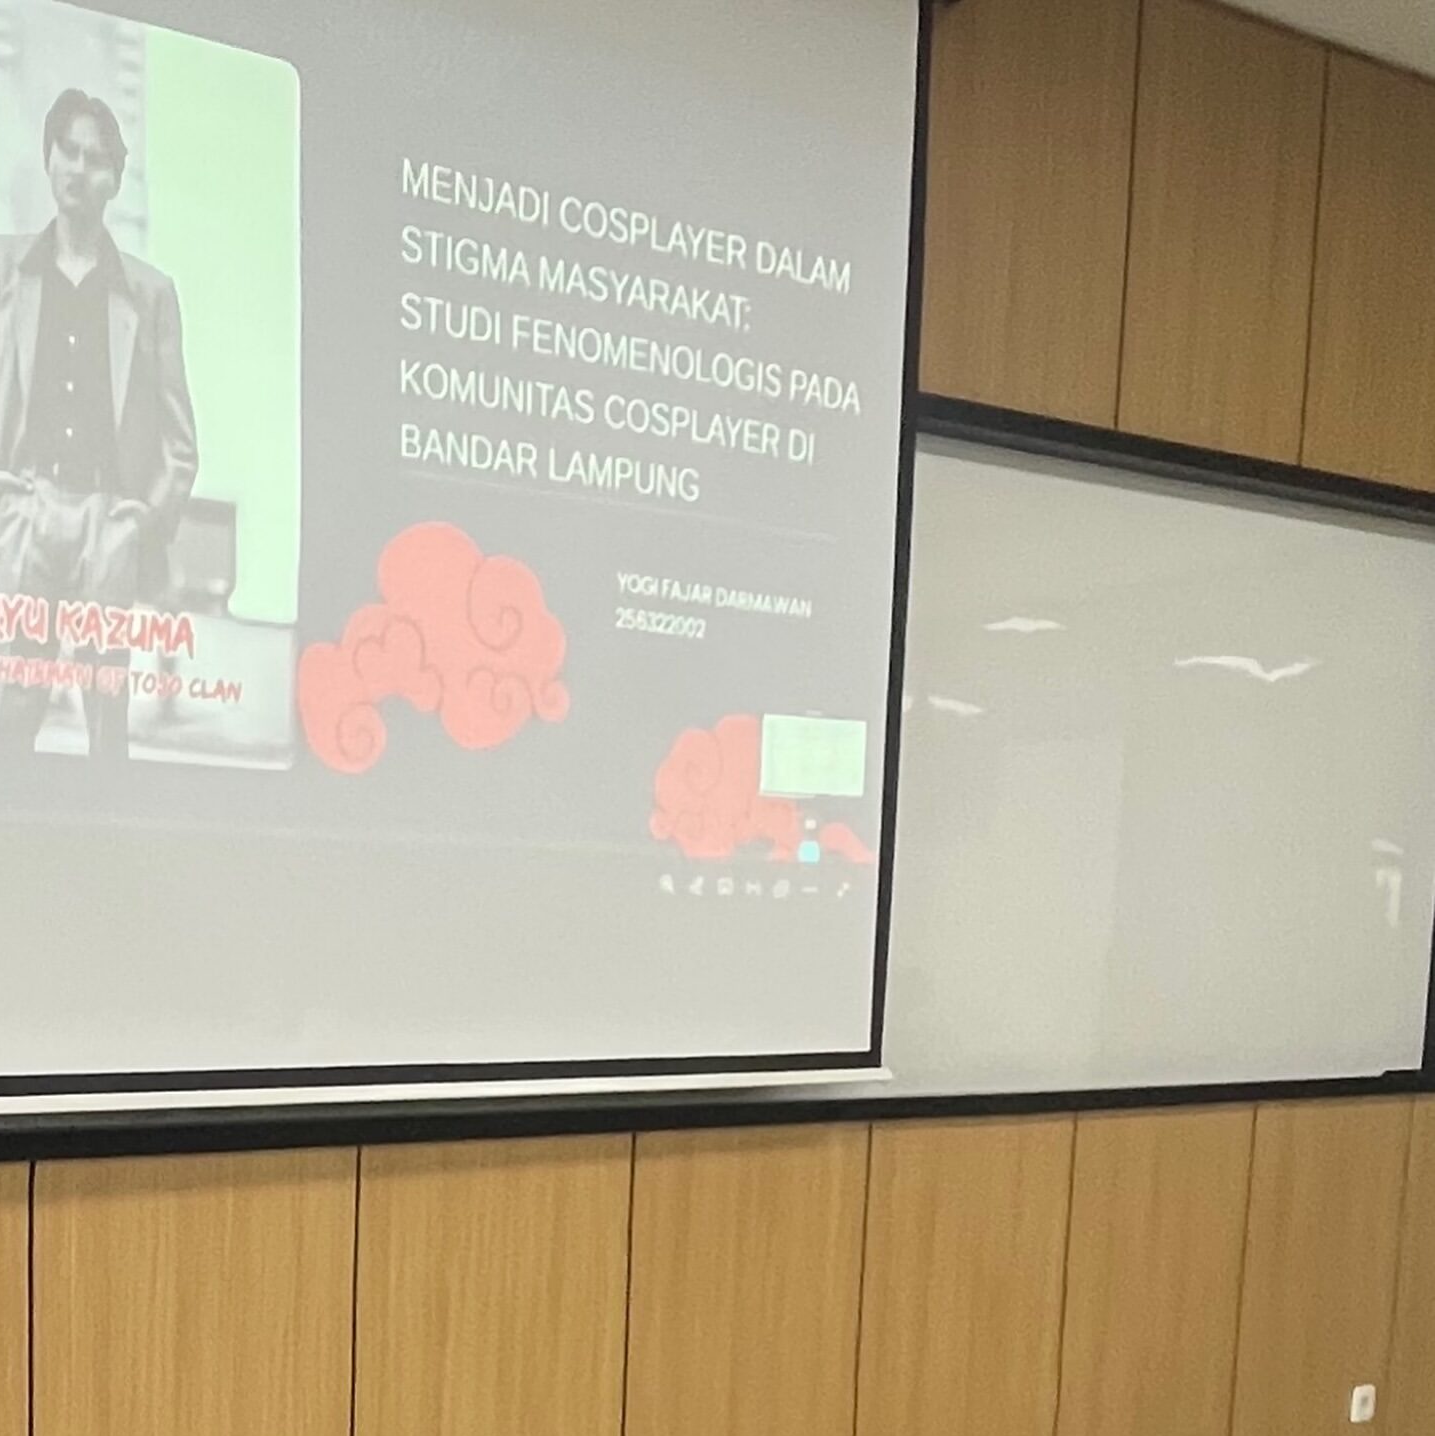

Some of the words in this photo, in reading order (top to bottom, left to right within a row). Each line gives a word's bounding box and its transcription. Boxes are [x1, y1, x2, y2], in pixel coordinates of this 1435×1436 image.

[401, 156, 550, 227] MENJADI
[559, 196, 746, 269] COSPLAYER
[756, 241, 851, 294] DALAM
[401, 224, 531, 288] STIGMA
[538, 255, 752, 332] MASYARAKAT:
[400, 292, 501, 345] STUDI
[512, 314, 782, 397] FENOMENOLOGIS
[789, 369, 861, 415] PADA
[400, 359, 595, 424] KOMUNITAS
[603, 394, 779, 457] COSPLAYER
[788, 428, 815, 465] DI
[400, 423, 538, 479] BANDAR
[549, 447, 700, 502] LAMPUNG
[56, 600, 196, 660] KAZUMA
[617, 571, 658, 596] YOGI
[661, 578, 713, 605] FAJAR
[715, 586, 812, 618] DARMAWAN
[96, 666, 128, 697] OF
[131, 670, 183, 697] TOJO
[189, 677, 244, 704] CLAN
